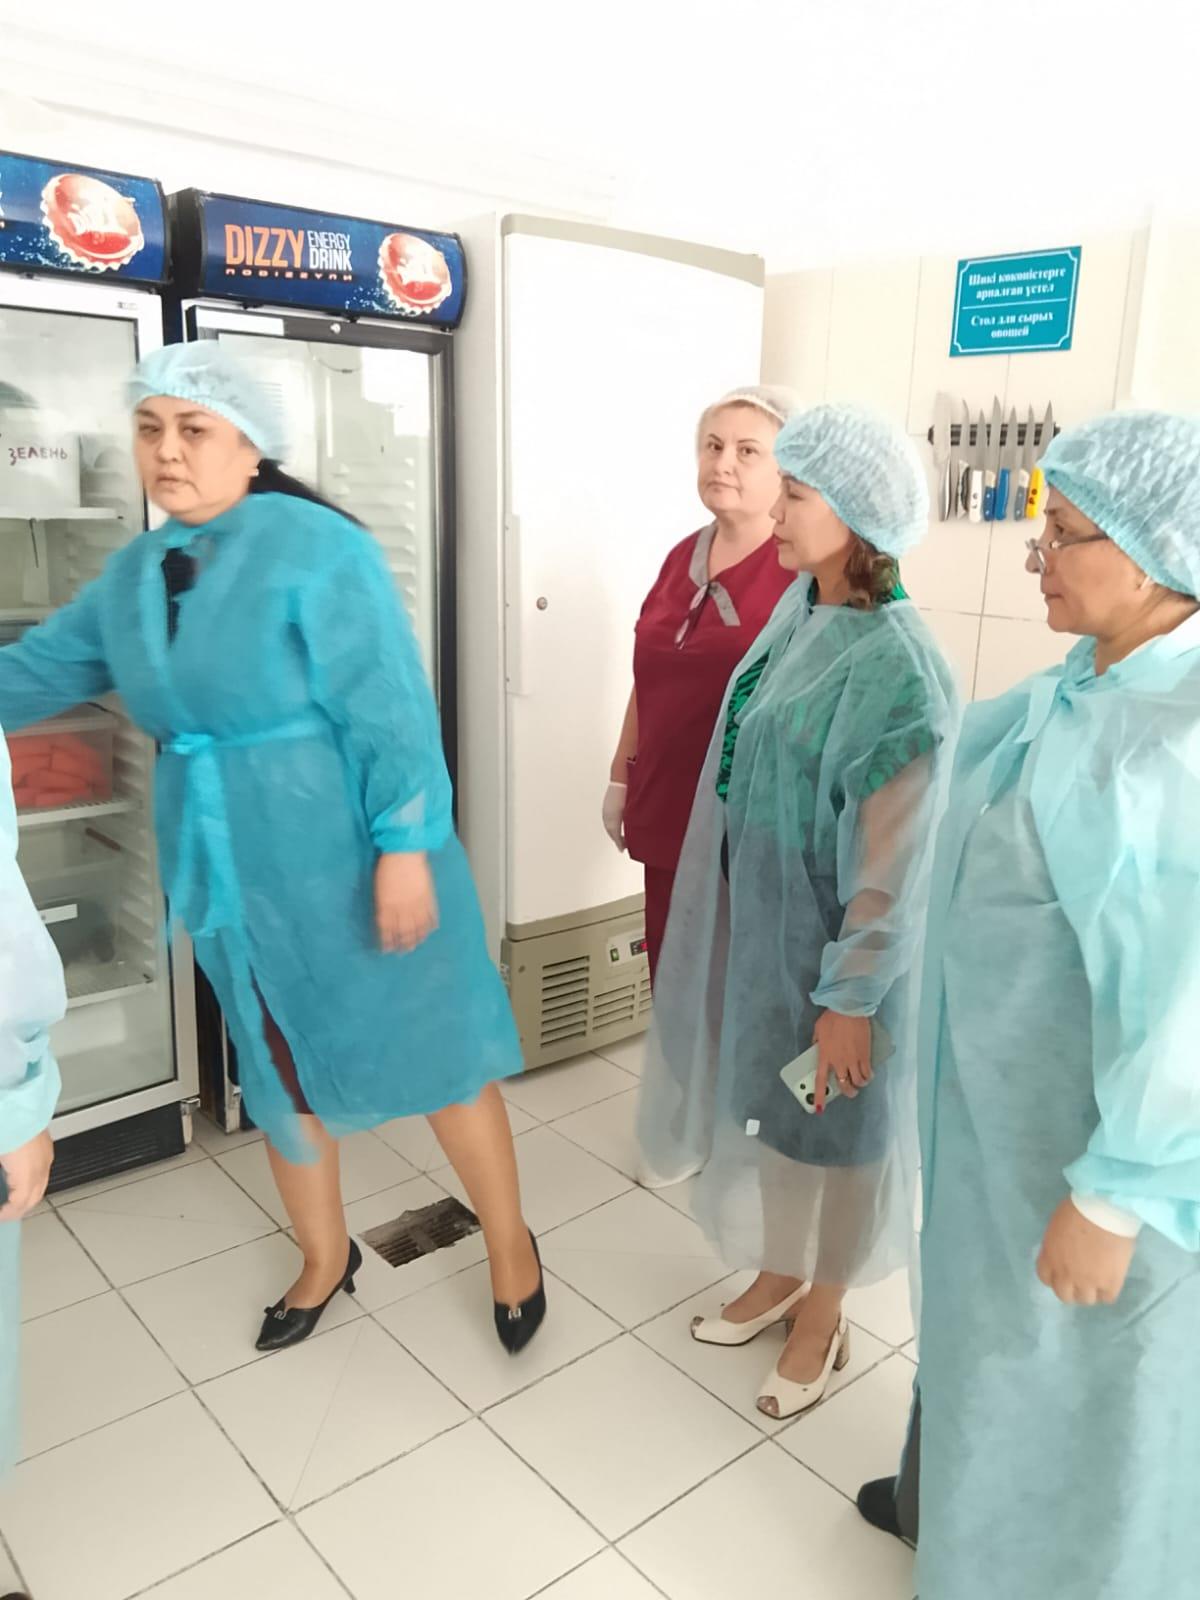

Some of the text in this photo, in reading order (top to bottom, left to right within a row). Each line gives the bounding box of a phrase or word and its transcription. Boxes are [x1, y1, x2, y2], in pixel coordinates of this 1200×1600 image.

[224, 223, 305, 269] DIZZY
[306, 229, 351, 251] ENERGY
[308, 247, 353, 272] DRINK
[971, 312, 1053, 326] Стол для сырых
[7, 445, 69, 467] ЗЕЛЕНЬ
